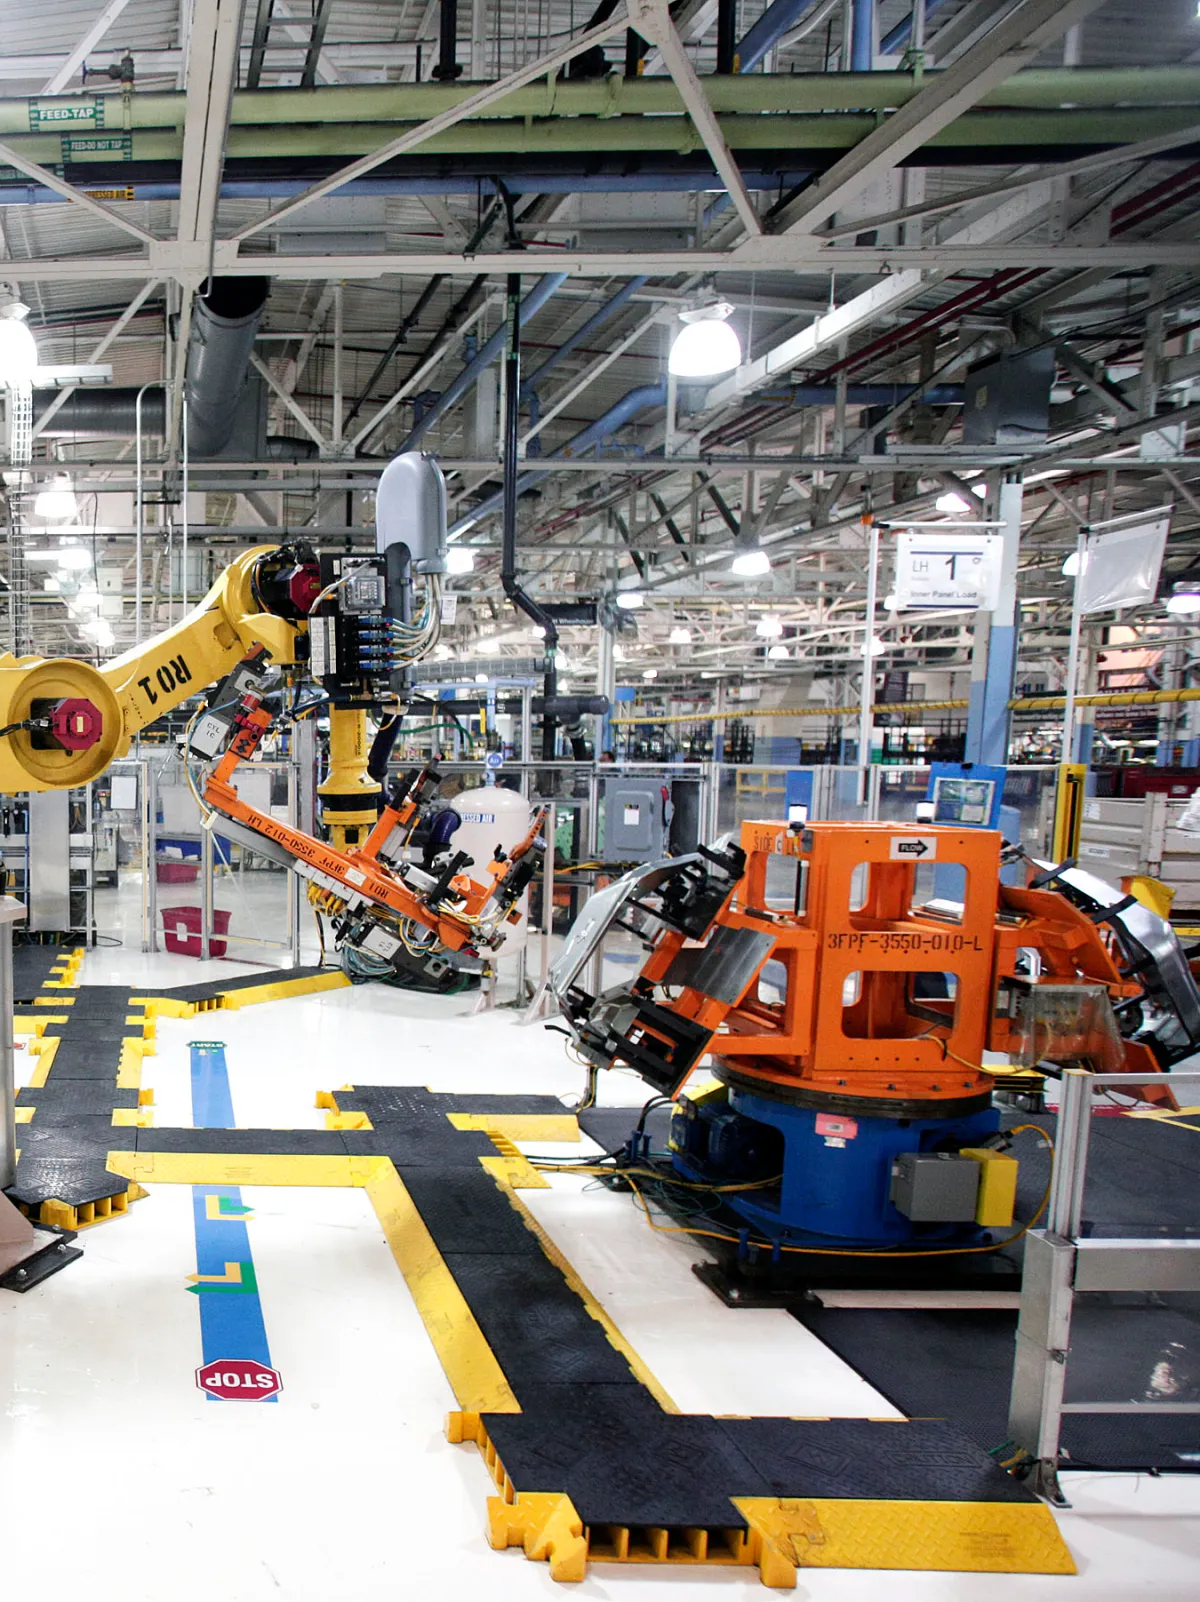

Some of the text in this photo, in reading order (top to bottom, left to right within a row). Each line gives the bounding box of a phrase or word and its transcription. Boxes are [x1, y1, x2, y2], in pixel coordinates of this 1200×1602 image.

[39, 107, 94, 120] FEED-TAP
[71, 139, 123, 151] FEED-DO NOT TAP
[912, 555, 957, 581] LH 1
[932, 590, 954, 598] Panel
[956, 591, 978, 599] Load
[137, 653, 193, 706] R01
[207, 722, 220, 734] CYL
[264, 824, 316, 859] 3550-012
[900, 843, 924, 852] FLOW
[827, 933, 984, 952] 3FPF-3550-010-L
[205, 1372, 274, 1389] STOP
